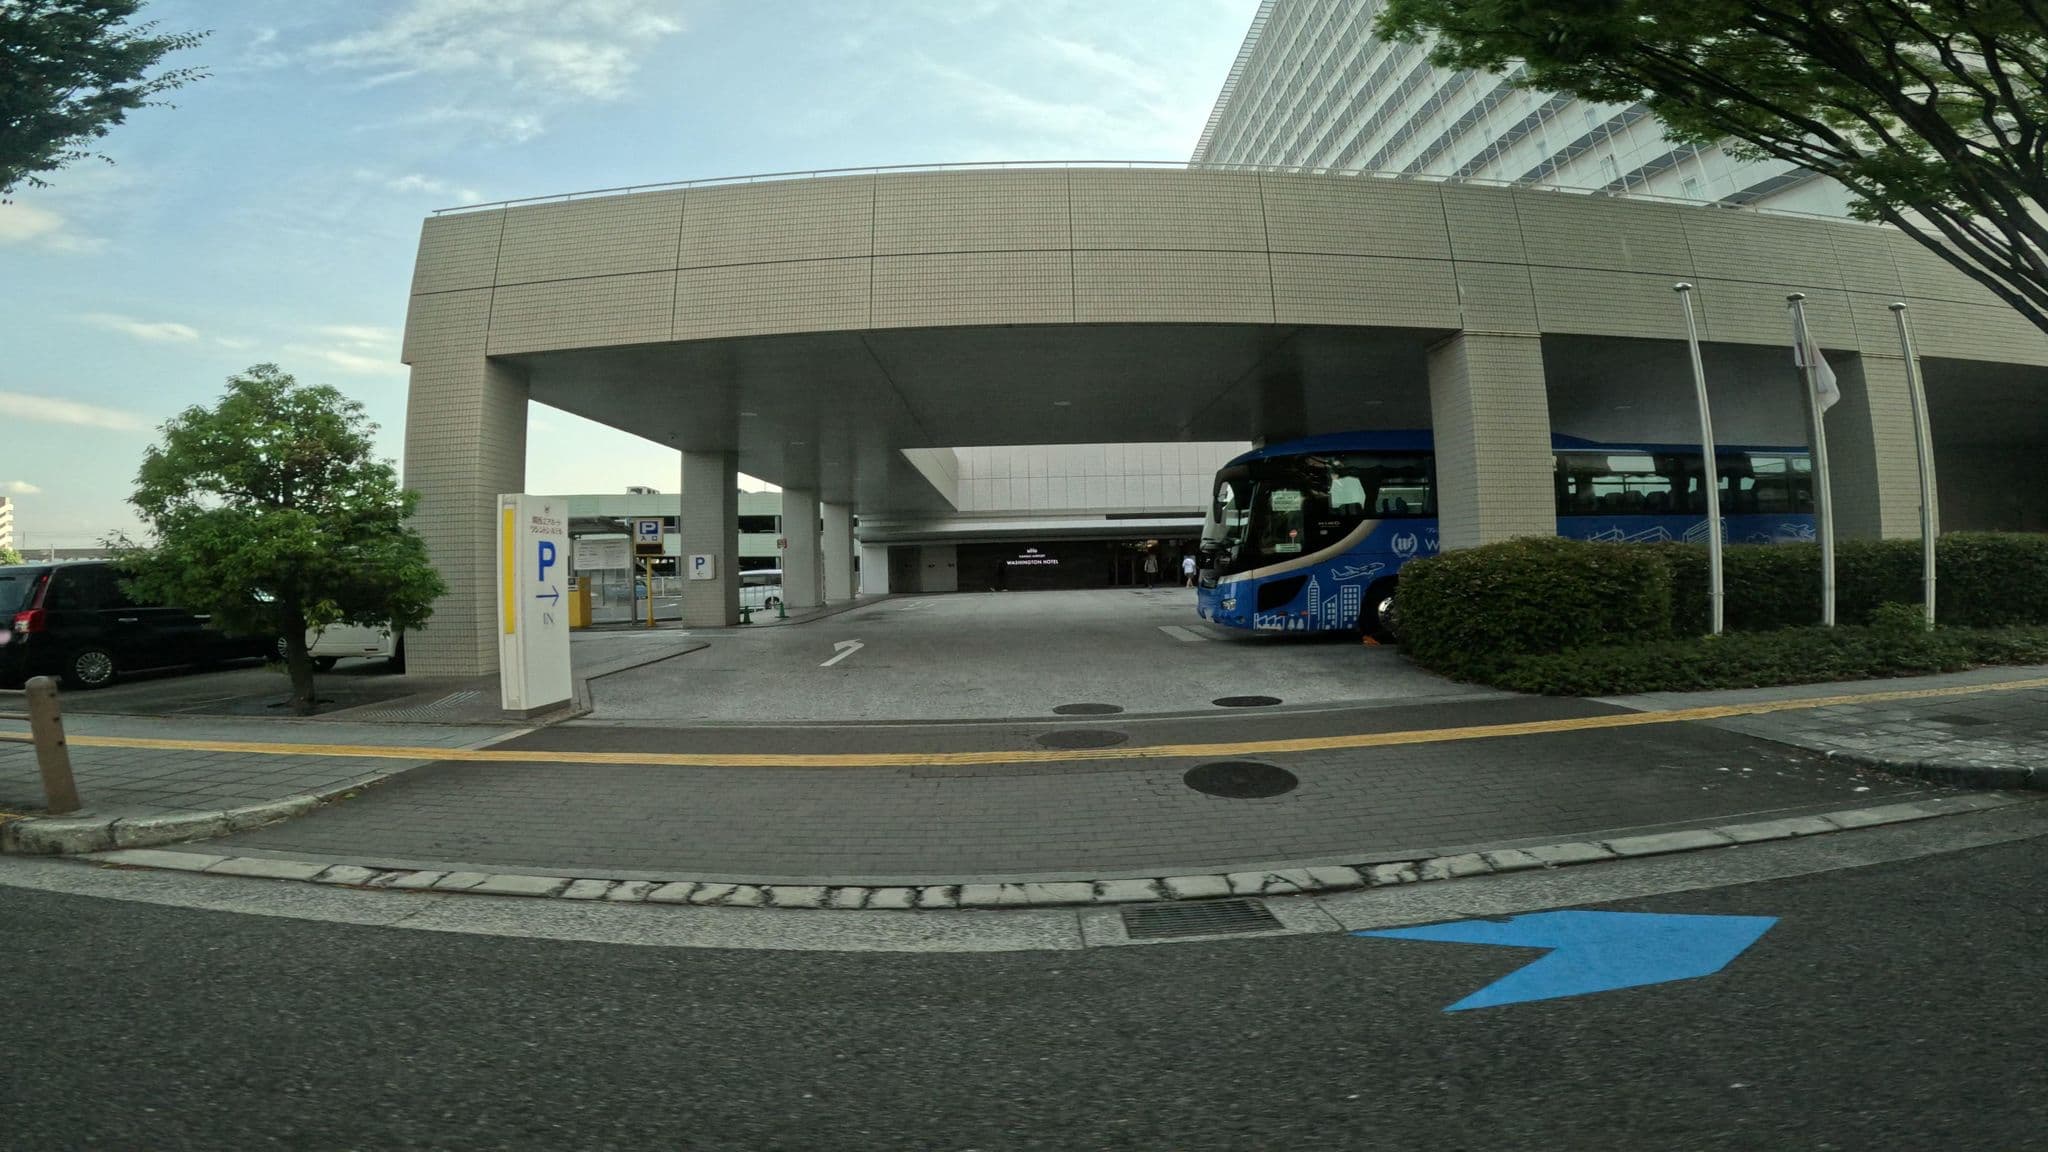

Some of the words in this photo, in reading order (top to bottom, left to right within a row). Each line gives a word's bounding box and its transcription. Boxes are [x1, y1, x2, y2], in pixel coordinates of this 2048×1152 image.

[641, 522, 656, 534] P
[538, 541, 556, 581] P
[695, 557, 705, 570] P
